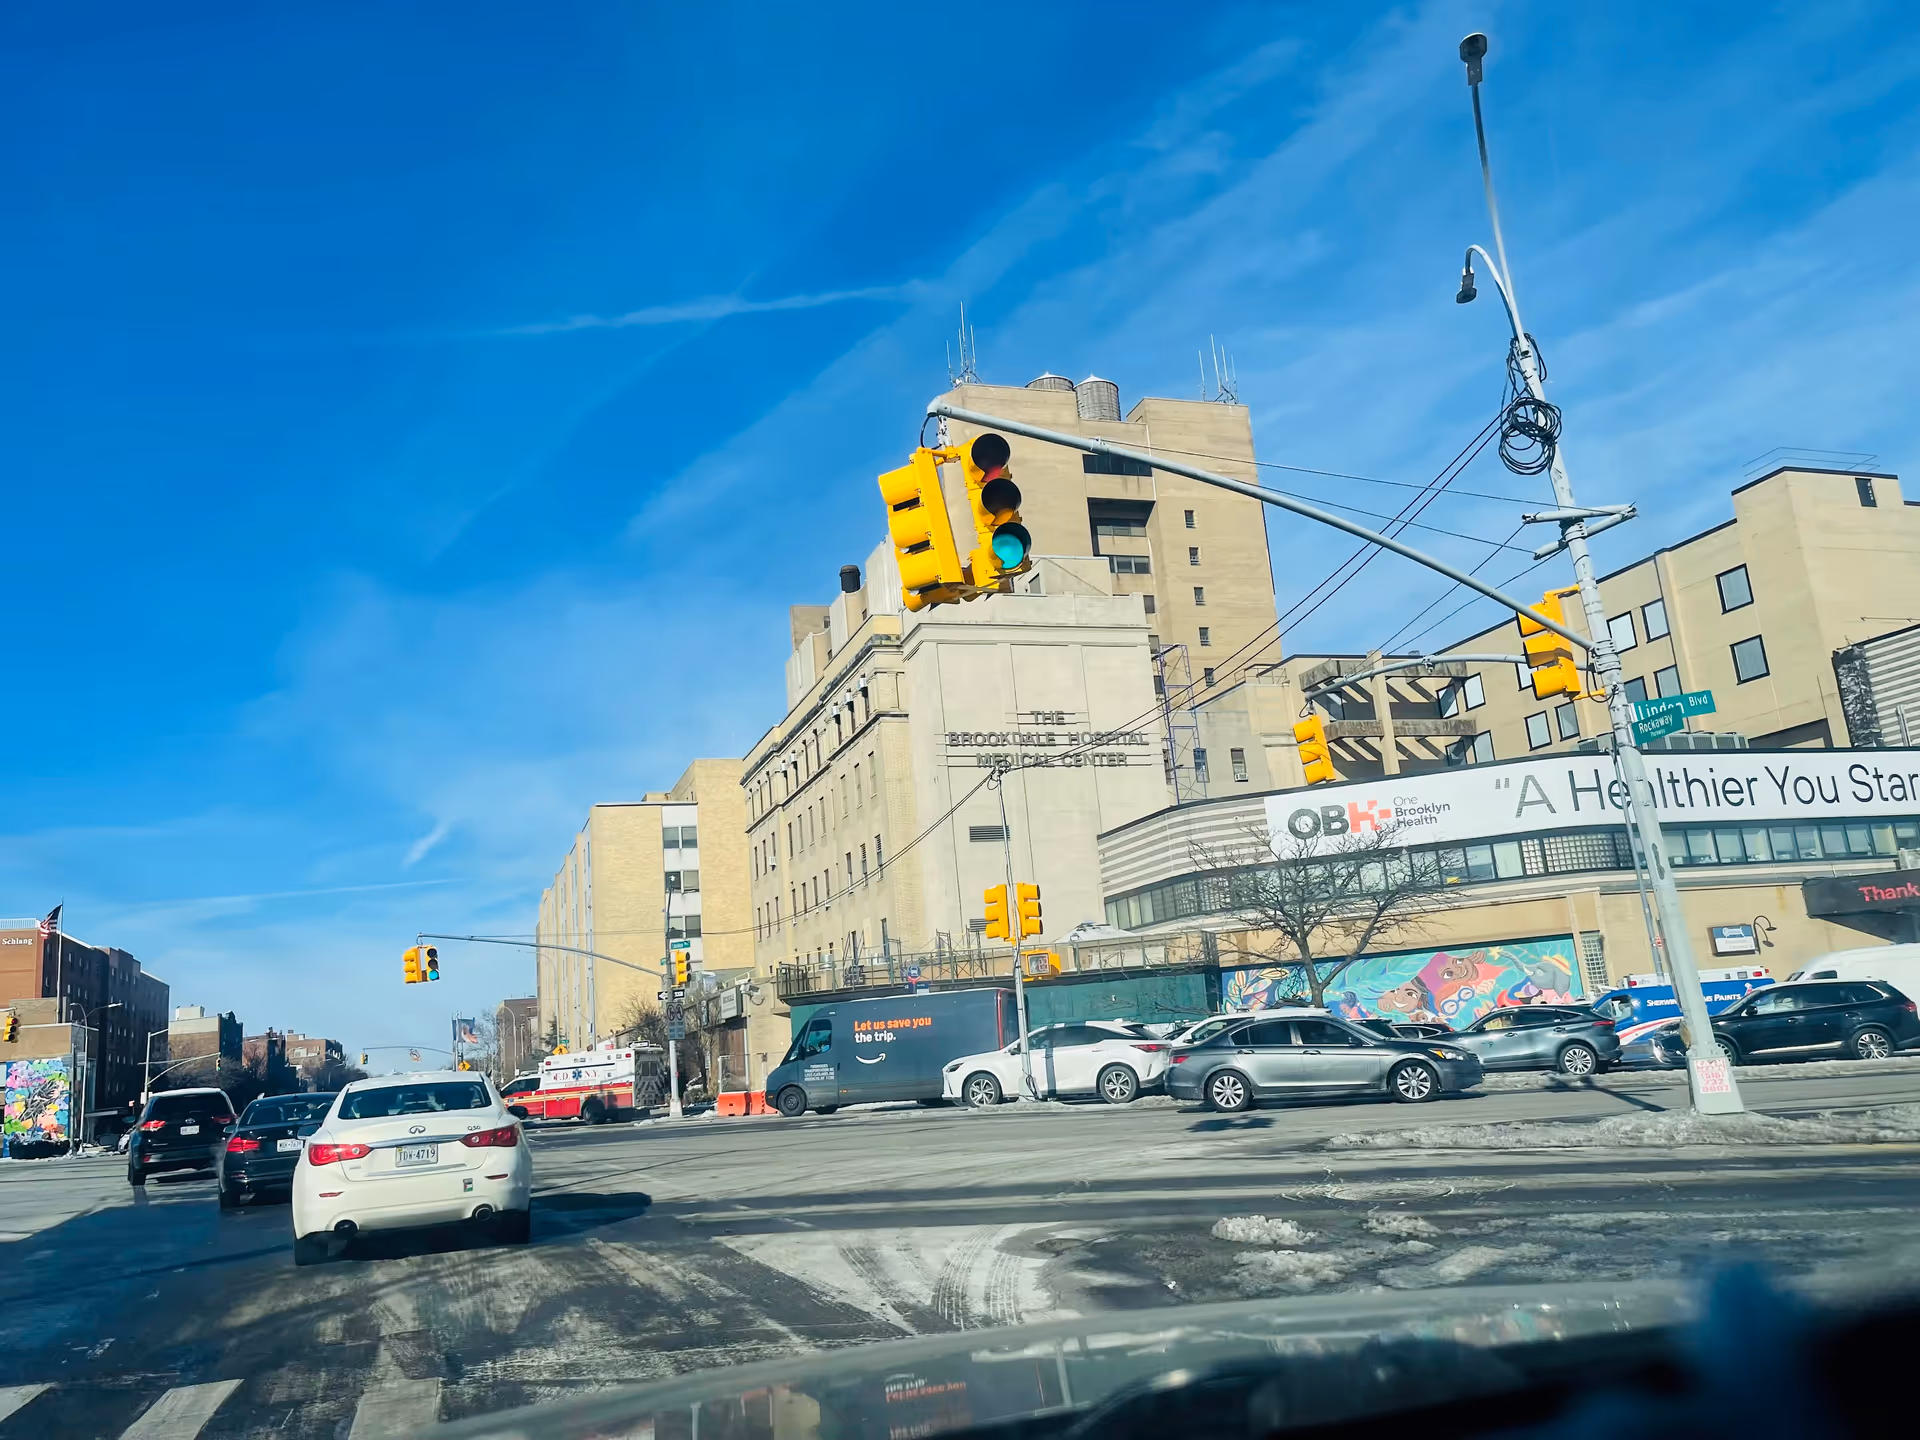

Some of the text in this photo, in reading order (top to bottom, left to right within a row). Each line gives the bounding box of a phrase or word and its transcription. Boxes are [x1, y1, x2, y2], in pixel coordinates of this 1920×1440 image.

[1688, 695, 1709, 707] Blvd
[1030, 711, 1066, 725] THE
[1638, 714, 1673, 734] Rockaway
[949, 730, 1150, 747] BROOKDALE HOSPITAL
[976, 751, 1129, 768] MEDICAL CENTER
[1567, 767, 1758, 812] Helthier
[1764, 765, 1841, 806] You
[1847, 763, 1920, 804] Star
[1393, 796, 1418, 807] One
[1395, 802, 1451, 818] Brooklyn
[1396, 814, 1438, 828] Health
[2, 937, 33, 946] Schlang
[1714, 993, 1741, 1002] PAINTS
[854, 1017, 932, 1032] Let us save you
[854, 1030, 897, 1043] the trip.
